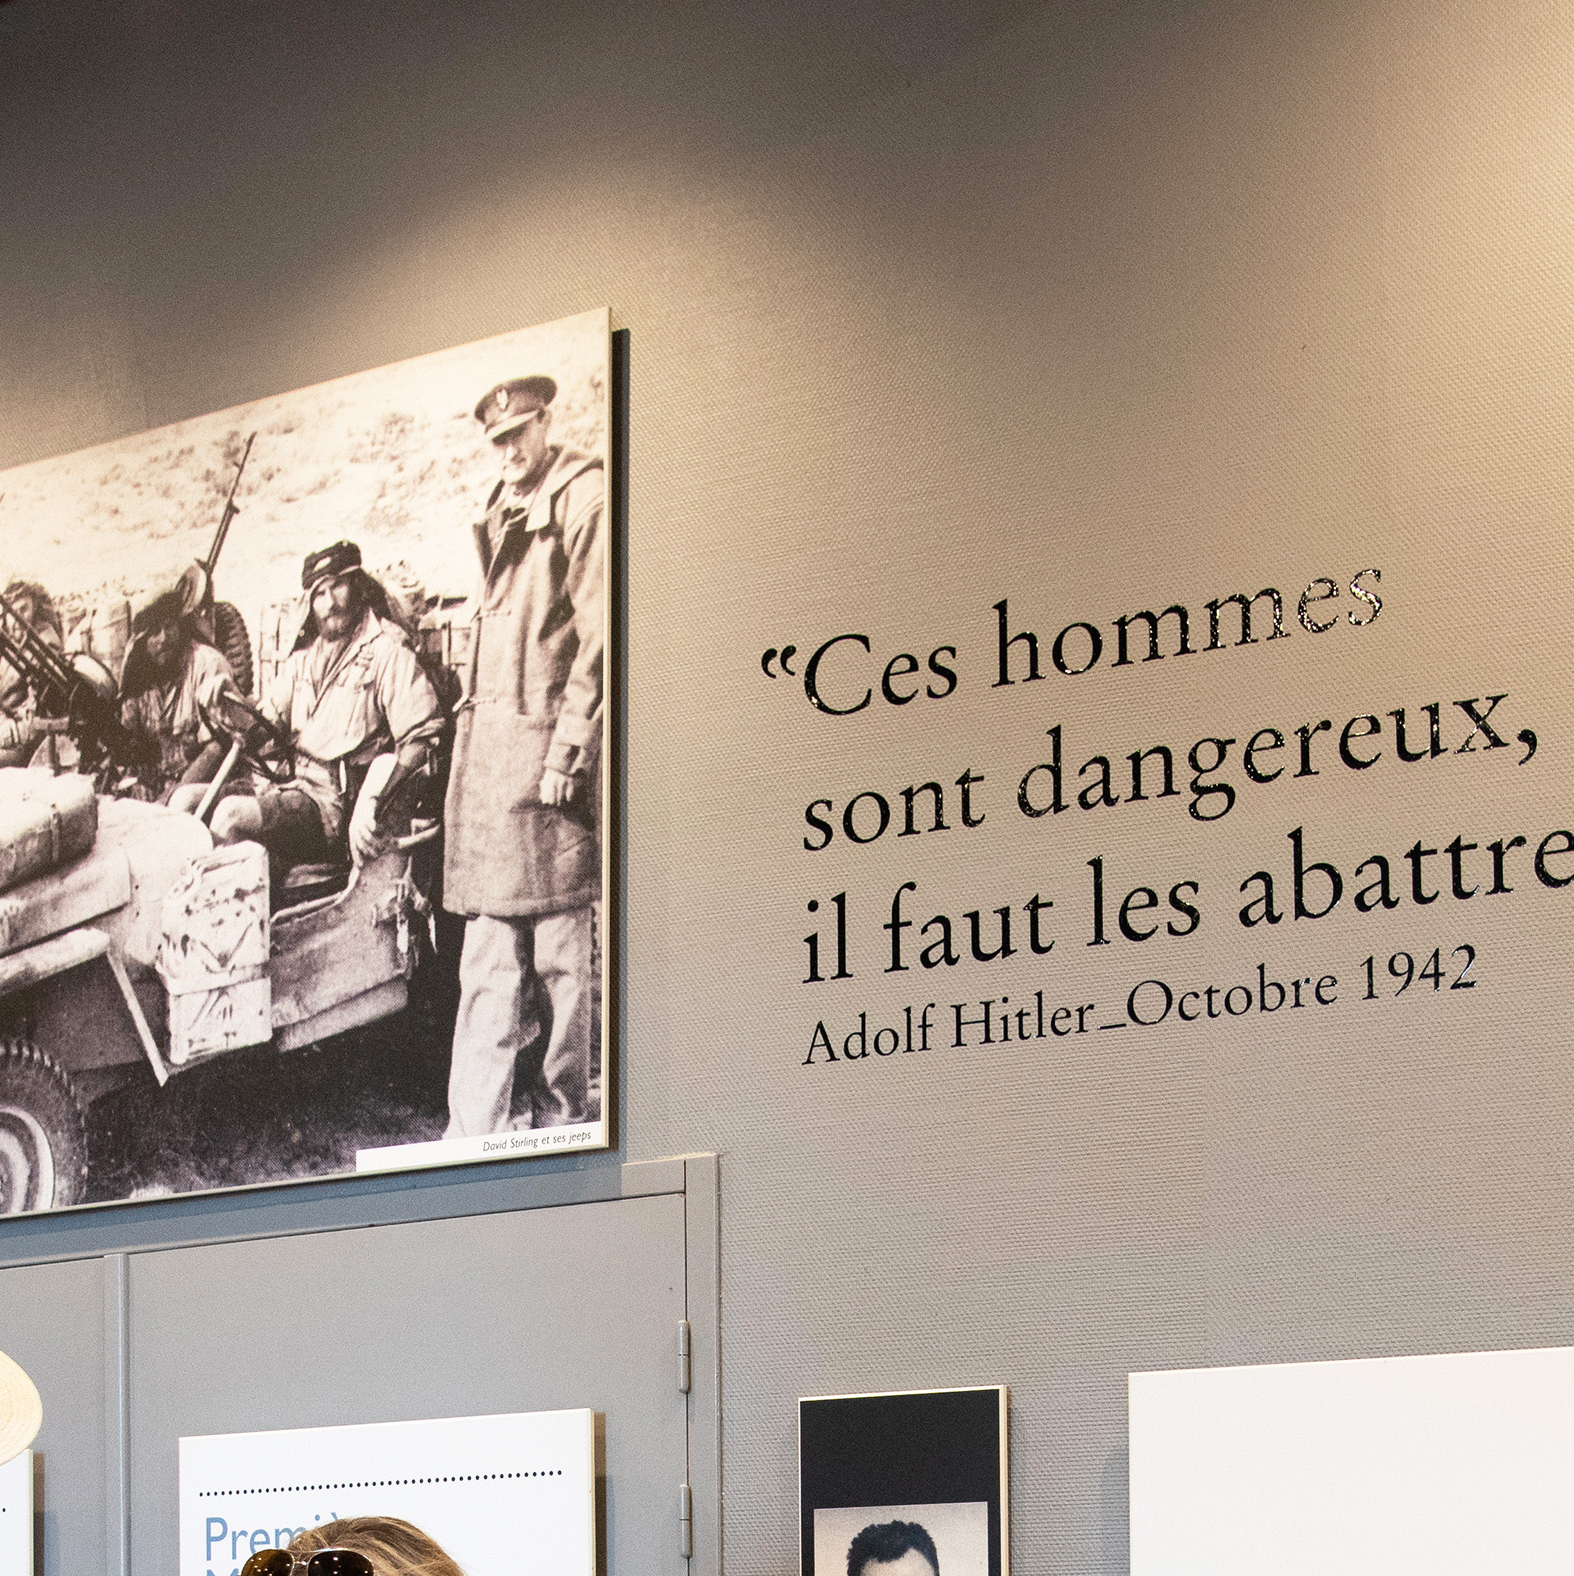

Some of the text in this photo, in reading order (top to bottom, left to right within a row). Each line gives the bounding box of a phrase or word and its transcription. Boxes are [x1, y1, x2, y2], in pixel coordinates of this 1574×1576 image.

[991, 568, 1384, 687] hommes
[803, 694, 1540, 851] sont dangereux,
[802, 891, 854, 983] il
[883, 882, 1055, 974] faut
[1087, 855, 1201, 947] les
[802, 944, 1477, 1065] Adolf Hitler_Octobre 1942
[483, 1141, 507, 1151] David
[510, 1138, 538, 1148] Stirling
[542, 1136, 550, 1145] et
[567, 1131, 592, 1143] jeeps
